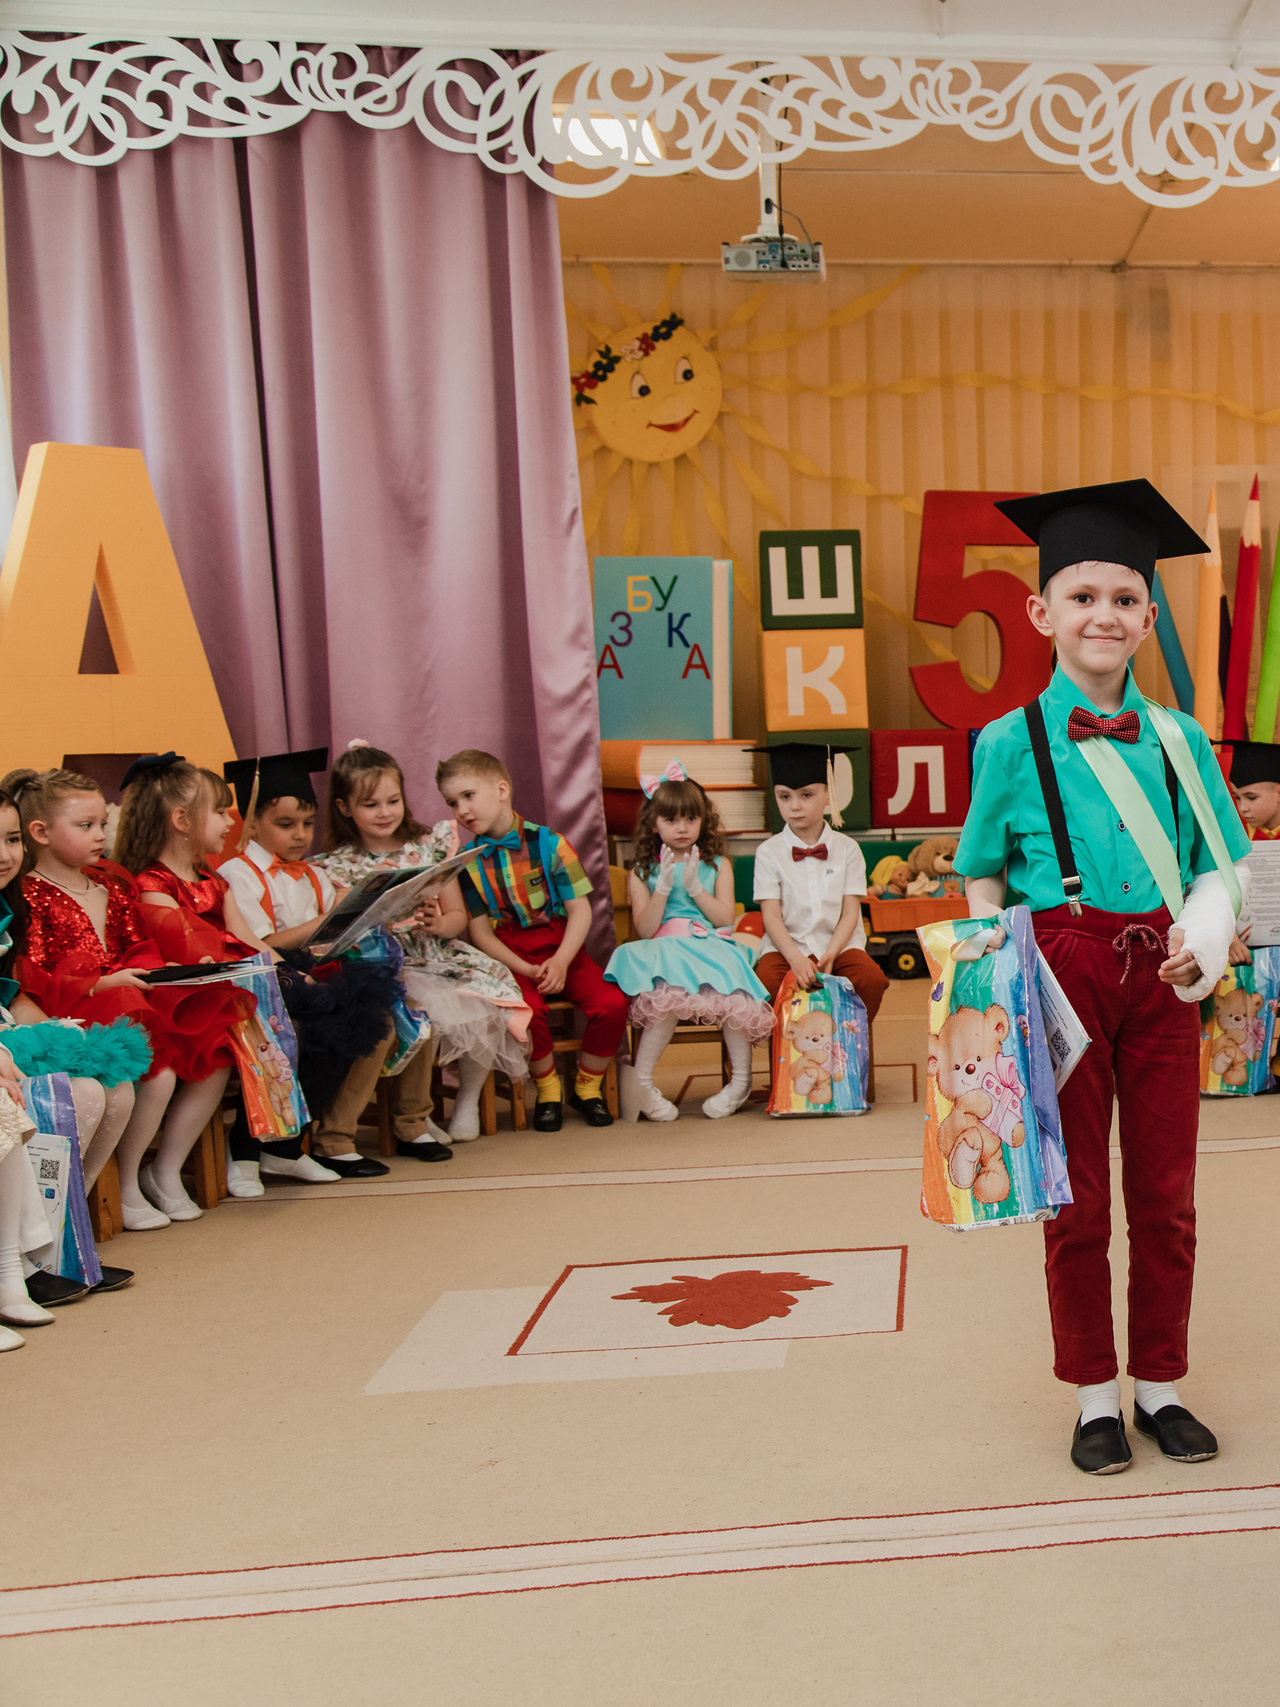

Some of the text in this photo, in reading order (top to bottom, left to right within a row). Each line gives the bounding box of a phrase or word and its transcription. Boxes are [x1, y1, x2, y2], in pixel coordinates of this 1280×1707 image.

[768, 545, 855, 615] Ш
[909, 490, 1057, 730] 5
[785, 645, 847, 715] К
[887, 745, 946, 815] Л
